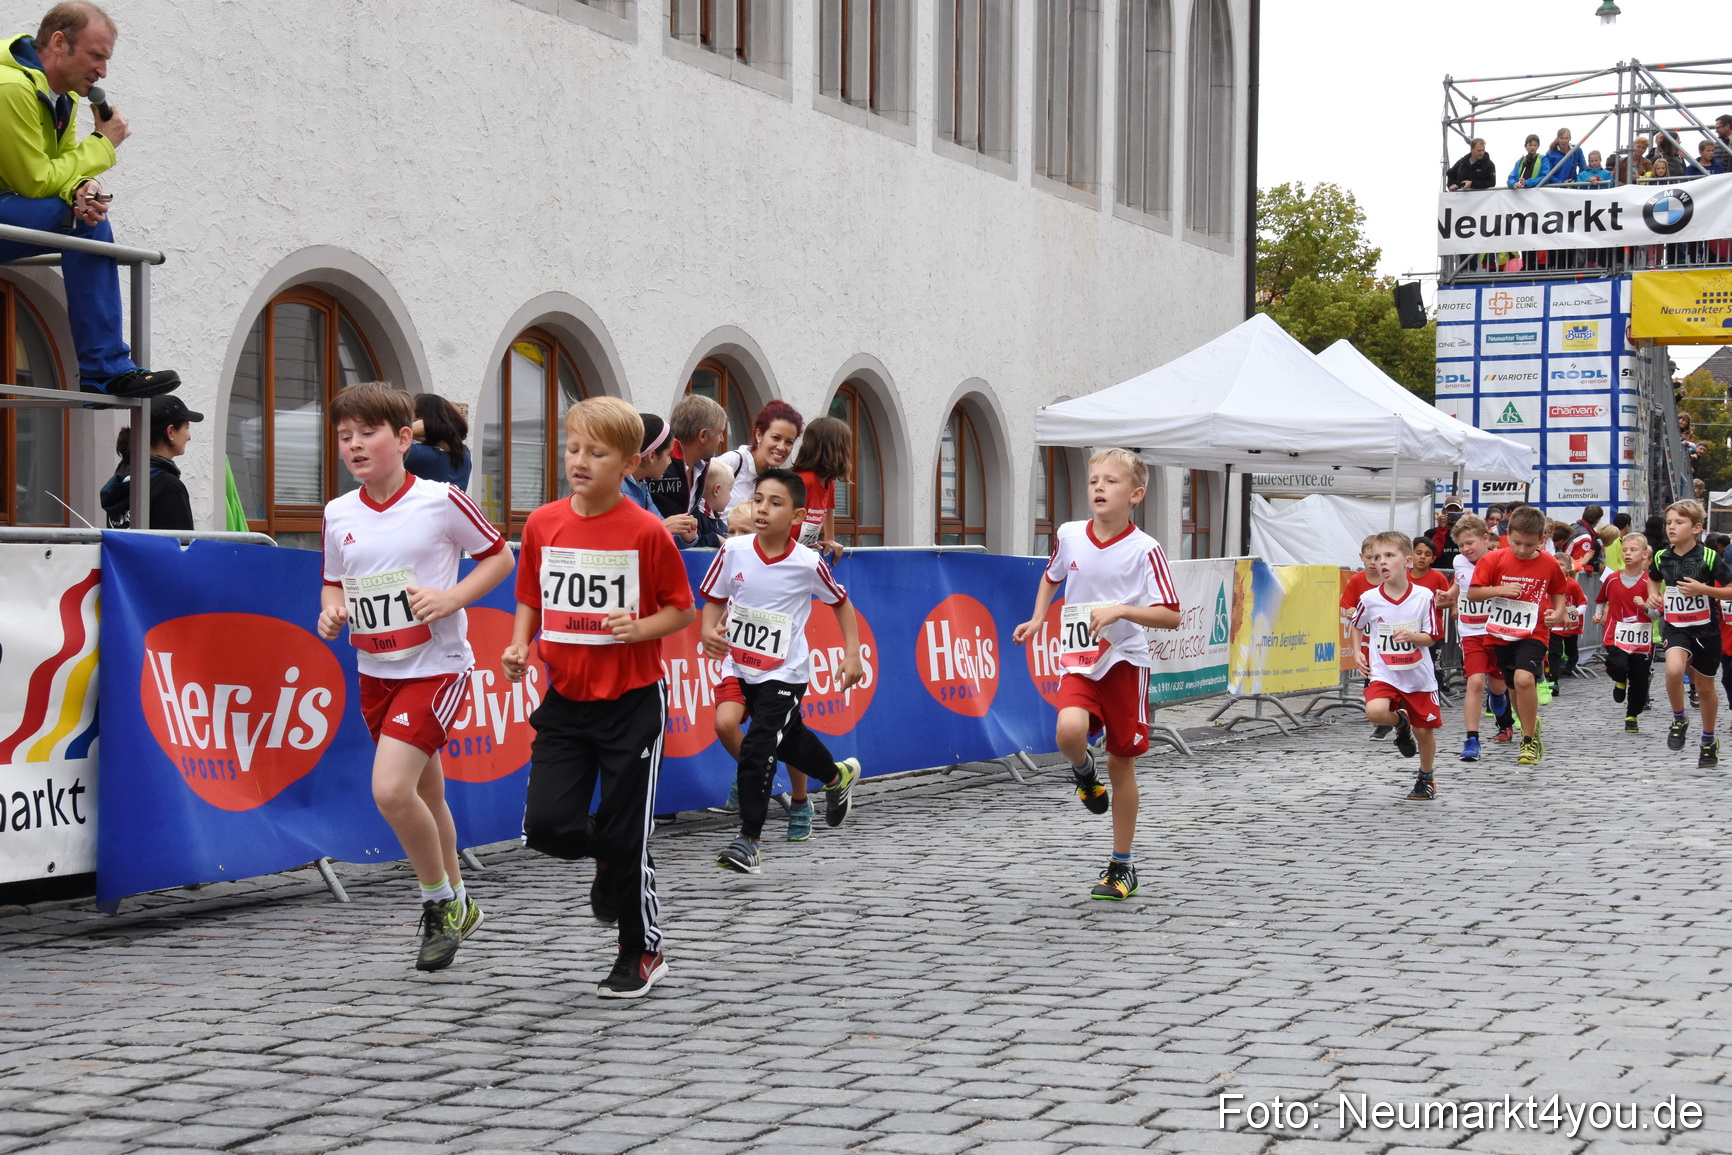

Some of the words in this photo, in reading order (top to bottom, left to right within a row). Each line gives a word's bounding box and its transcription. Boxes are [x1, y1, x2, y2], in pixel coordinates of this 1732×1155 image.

[1437, 302, 1472, 310] ARIOTEC
[1515, 295, 1535, 303] CODE
[1515, 301, 1539, 309] CLINIC
[1660, 304, 1724, 316] Neumarkter
[1497, 372, 1539, 381] VARIOTEC
[1550, 363, 1608, 380] RÖDL
[1568, 449, 1587, 458] Braun
[648, 480, 682, 494] CAMP
[1481, 481, 1519, 492] swn
[581, 553, 629, 566] BOCK
[361, 570, 408, 589] BOCK
[549, 571, 625, 608] 7051
[349, 589, 414, 629] 7071
[1667, 594, 1705, 612] 7026
[1495, 607, 1532, 628] 7041
[371, 634, 398, 650] Toni
[731, 618, 782, 655] 7021
[1620, 629, 1650, 644] 7018
[741, 652, 762, 668] Emre
[925, 620, 996, 693] Hervis
[1391, 655, 1414, 664] Simon
[146, 647, 333, 772] Hervis
[181, 755, 237, 780] SPORTS
